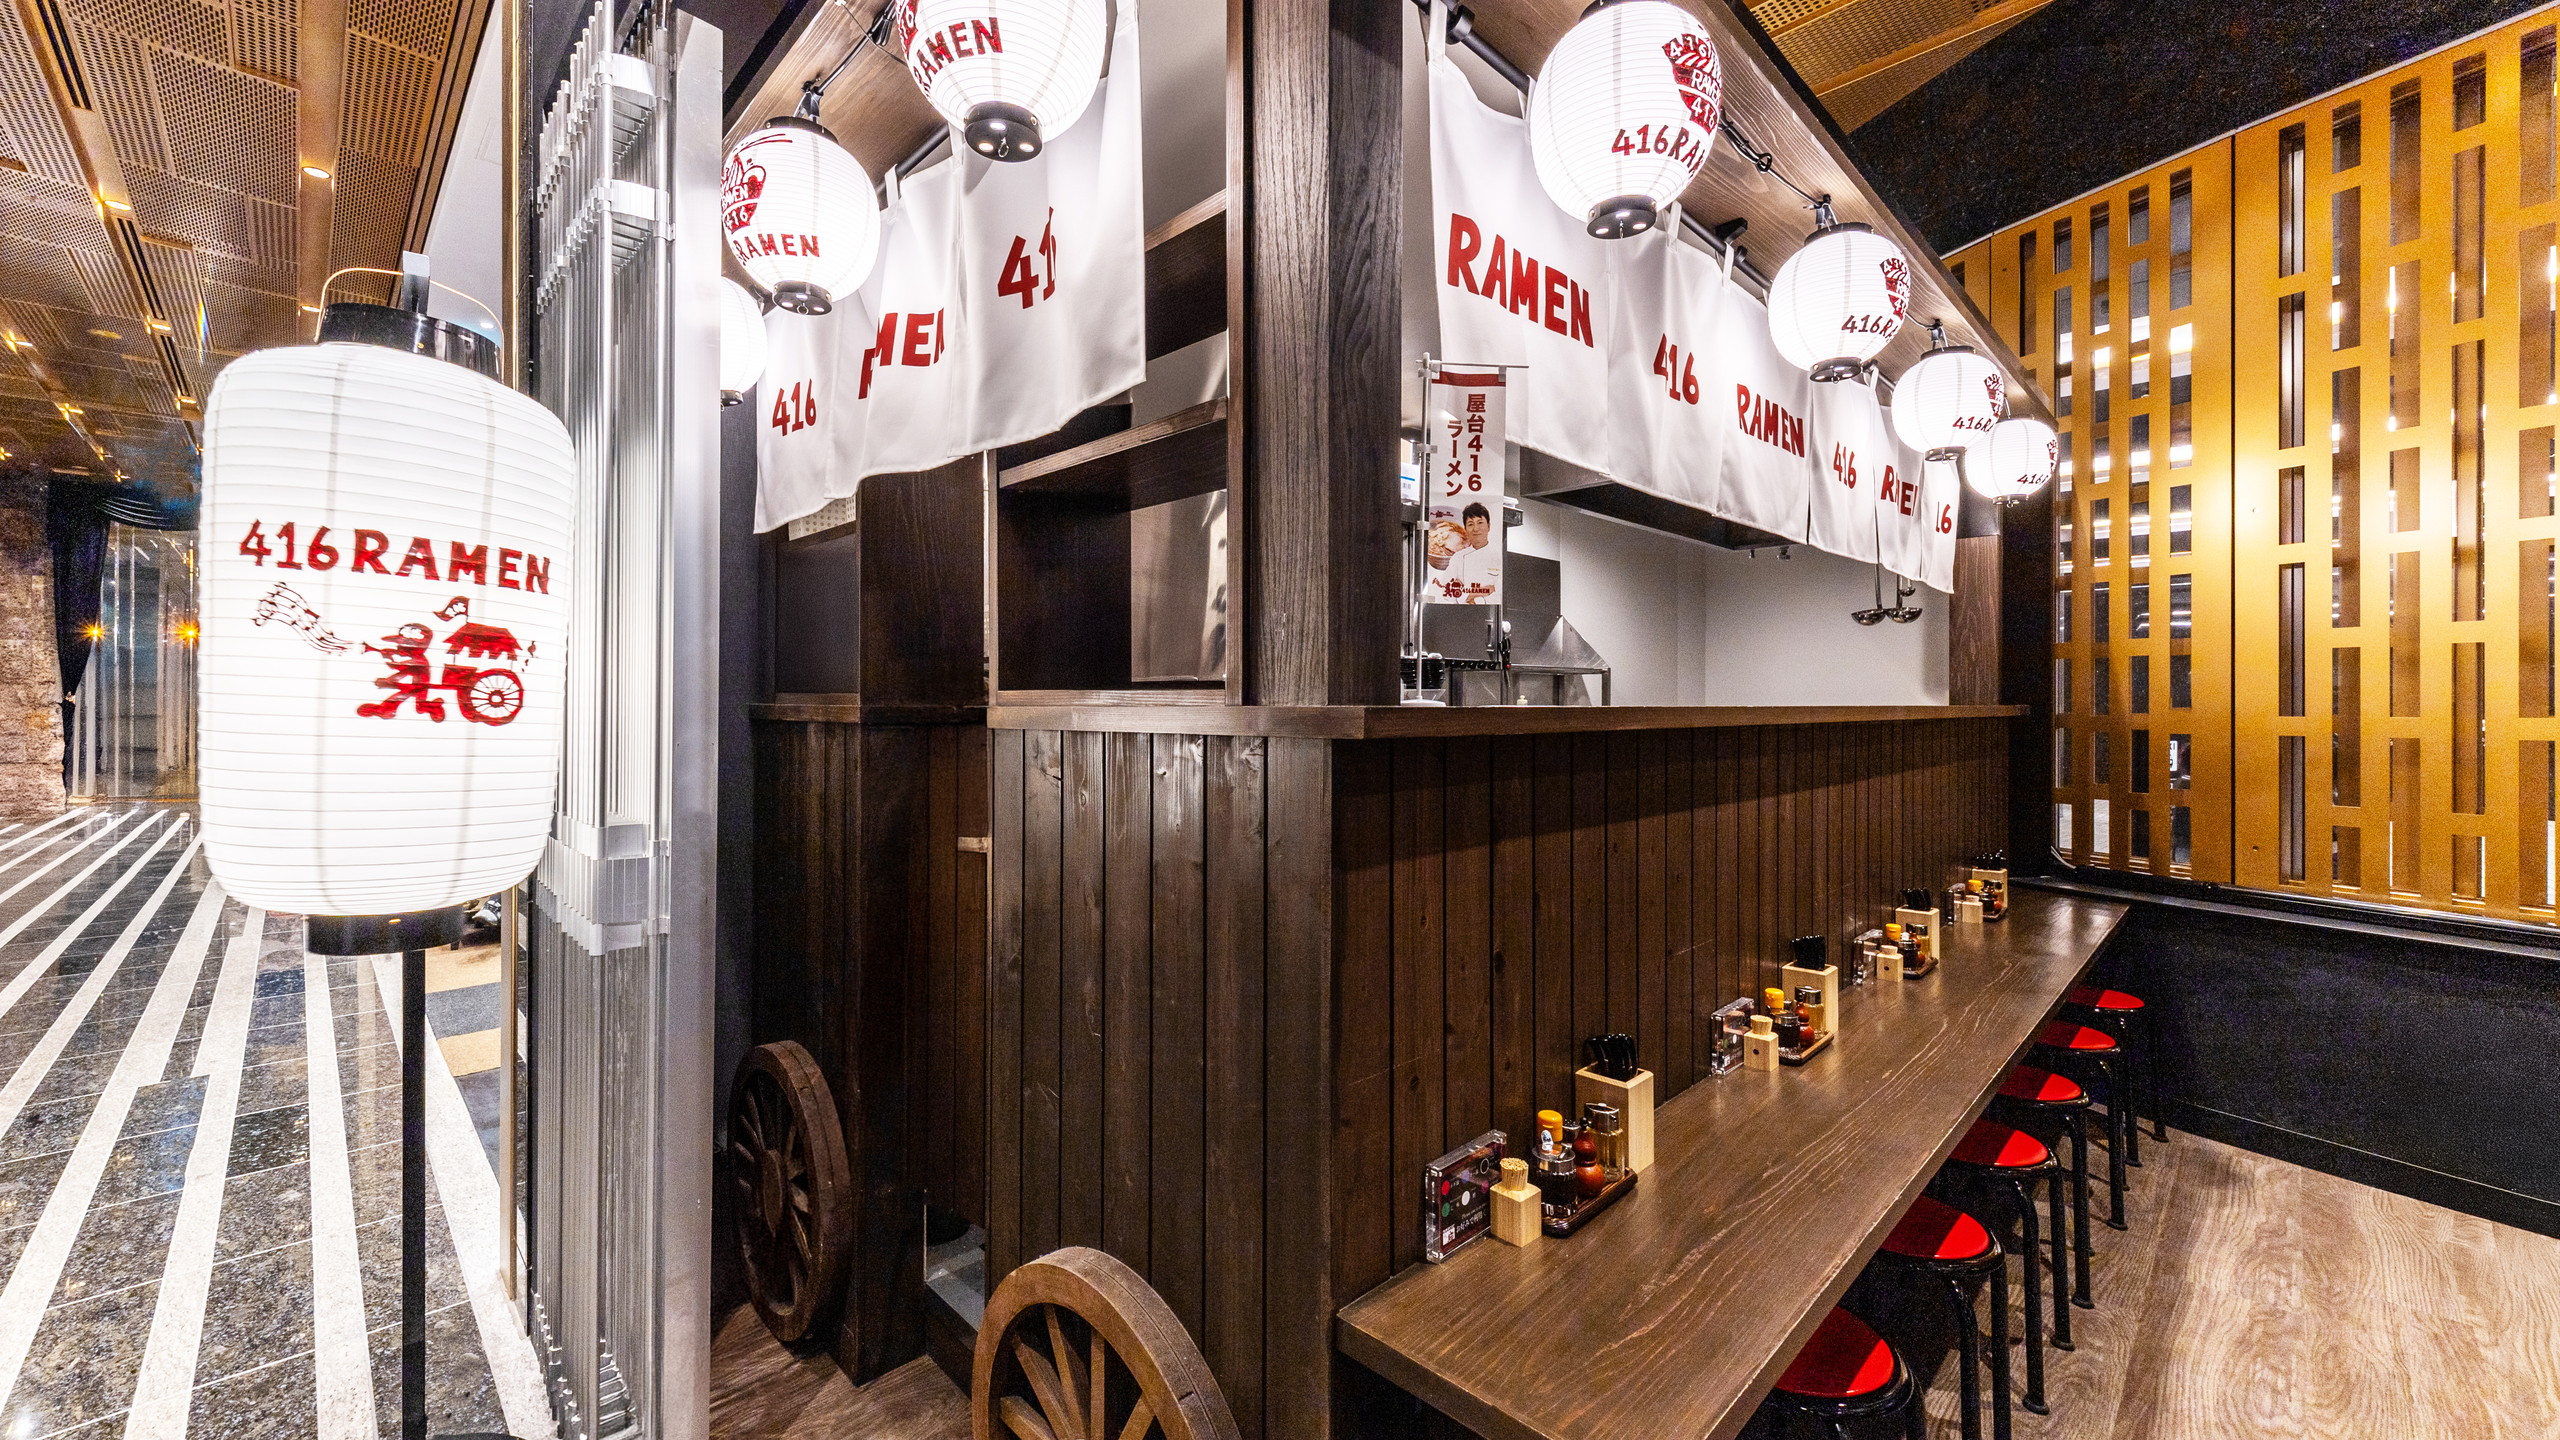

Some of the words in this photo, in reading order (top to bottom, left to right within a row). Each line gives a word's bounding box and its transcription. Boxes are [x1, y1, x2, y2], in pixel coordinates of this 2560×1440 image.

[1447, 212, 1595, 349] RAMEN
[771, 377, 817, 437] 416
[1653, 332, 1700, 406] 416
[1736, 383, 1805, 459] RAMEN
[1445, 420, 1465, 498] ラーメン
[1466, 393, 1487, 493] 屋台416
[1833, 440, 1857, 490] 416
